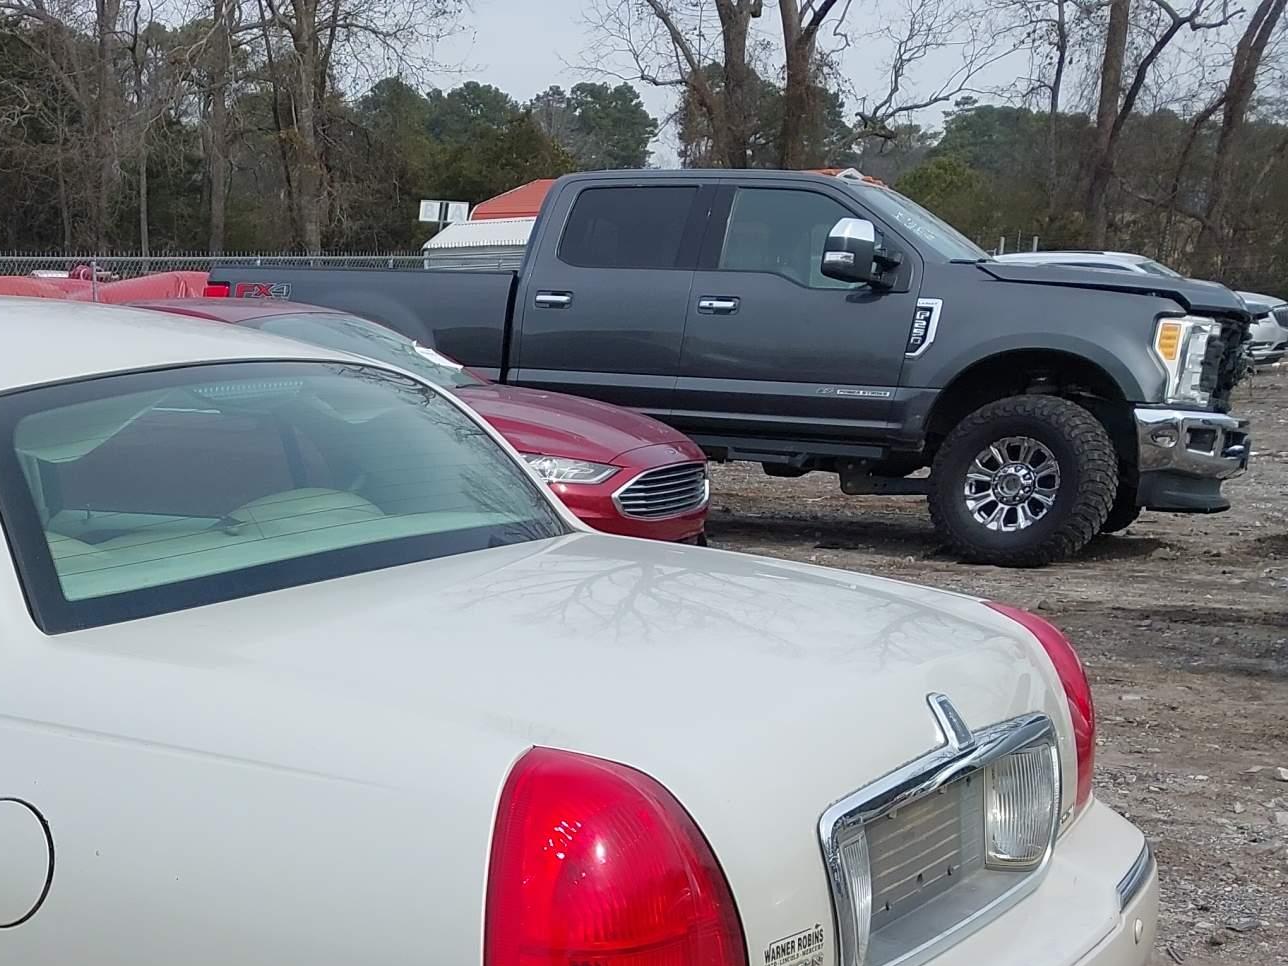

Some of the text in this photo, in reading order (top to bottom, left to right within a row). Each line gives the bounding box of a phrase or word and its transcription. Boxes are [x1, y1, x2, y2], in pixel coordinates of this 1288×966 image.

[235, 282, 292, 299] FX4
[764, 928, 824, 964] WARNER ROBINS
